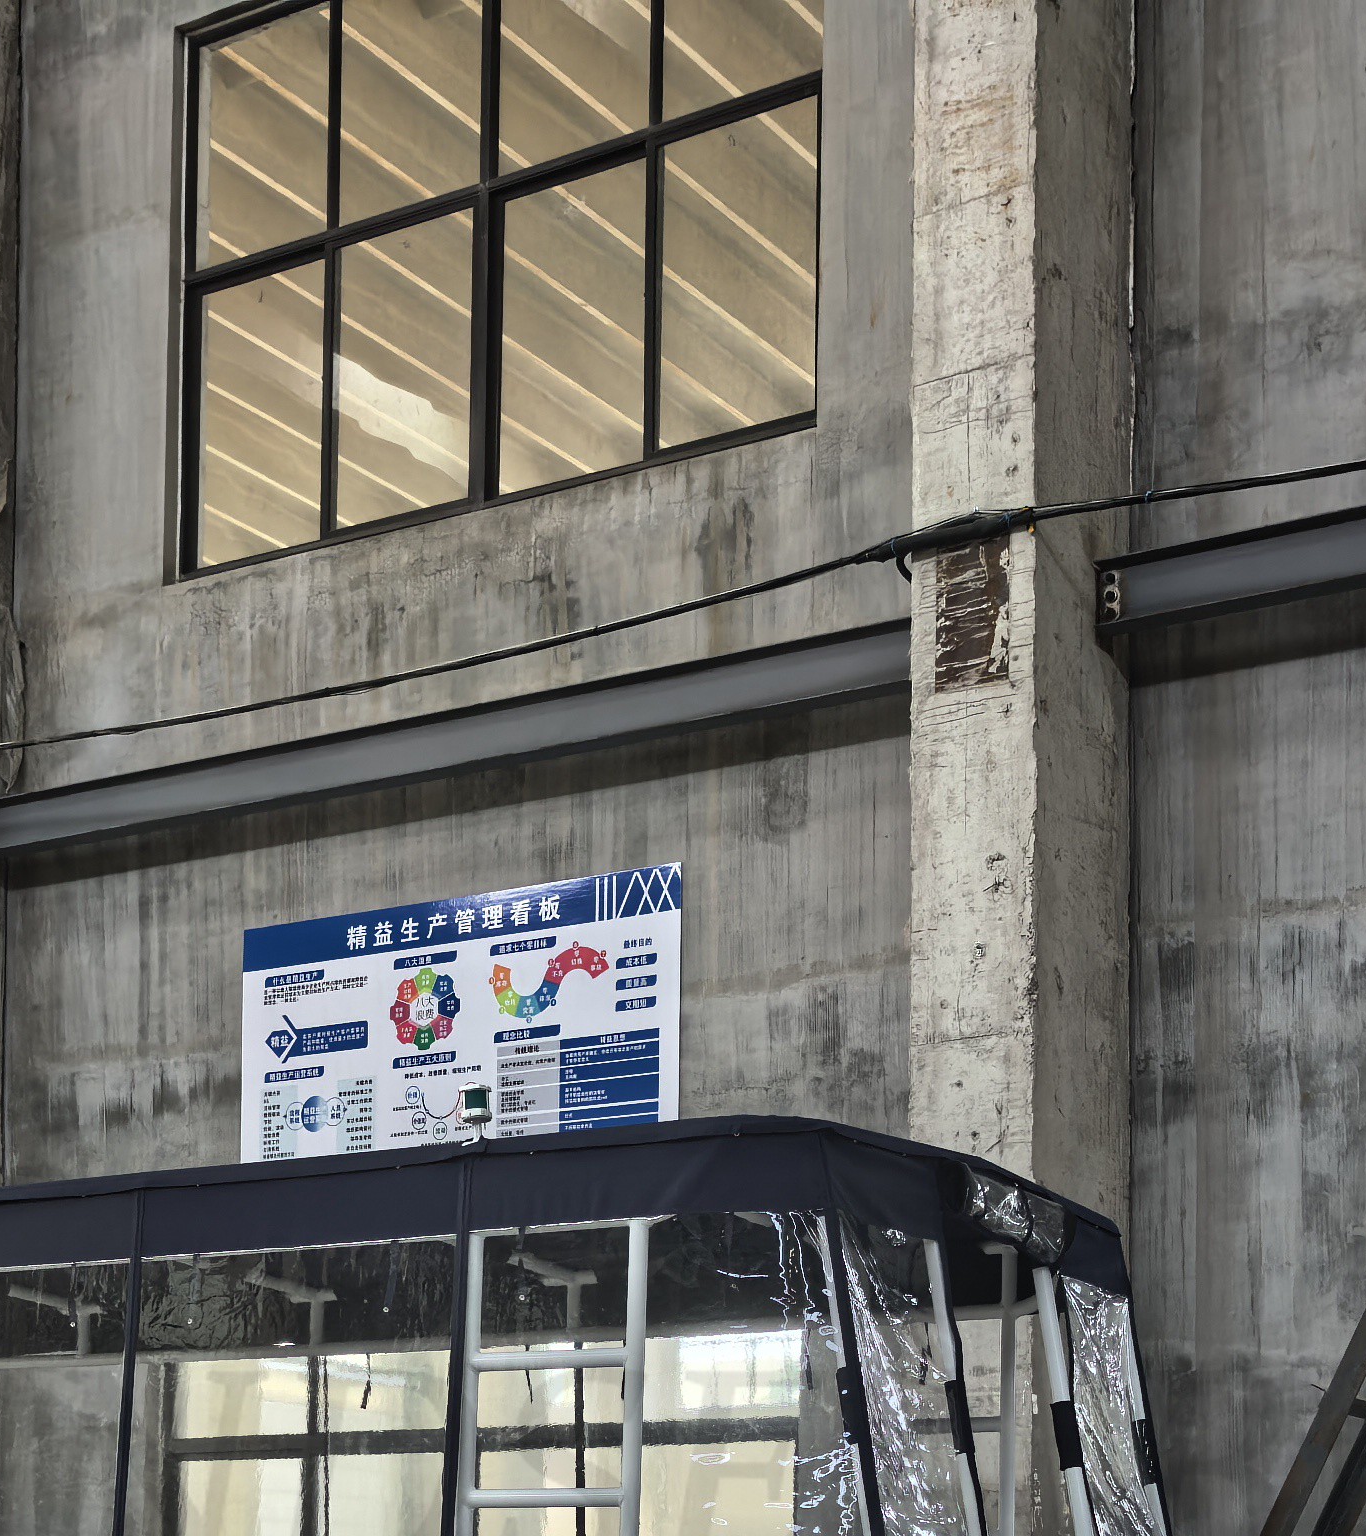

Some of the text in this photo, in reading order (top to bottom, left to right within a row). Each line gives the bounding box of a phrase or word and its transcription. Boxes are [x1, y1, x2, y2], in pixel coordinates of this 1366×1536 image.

[346, 893, 561, 951] 精益生产管理看板
[416, 997, 434, 1007] 八大
